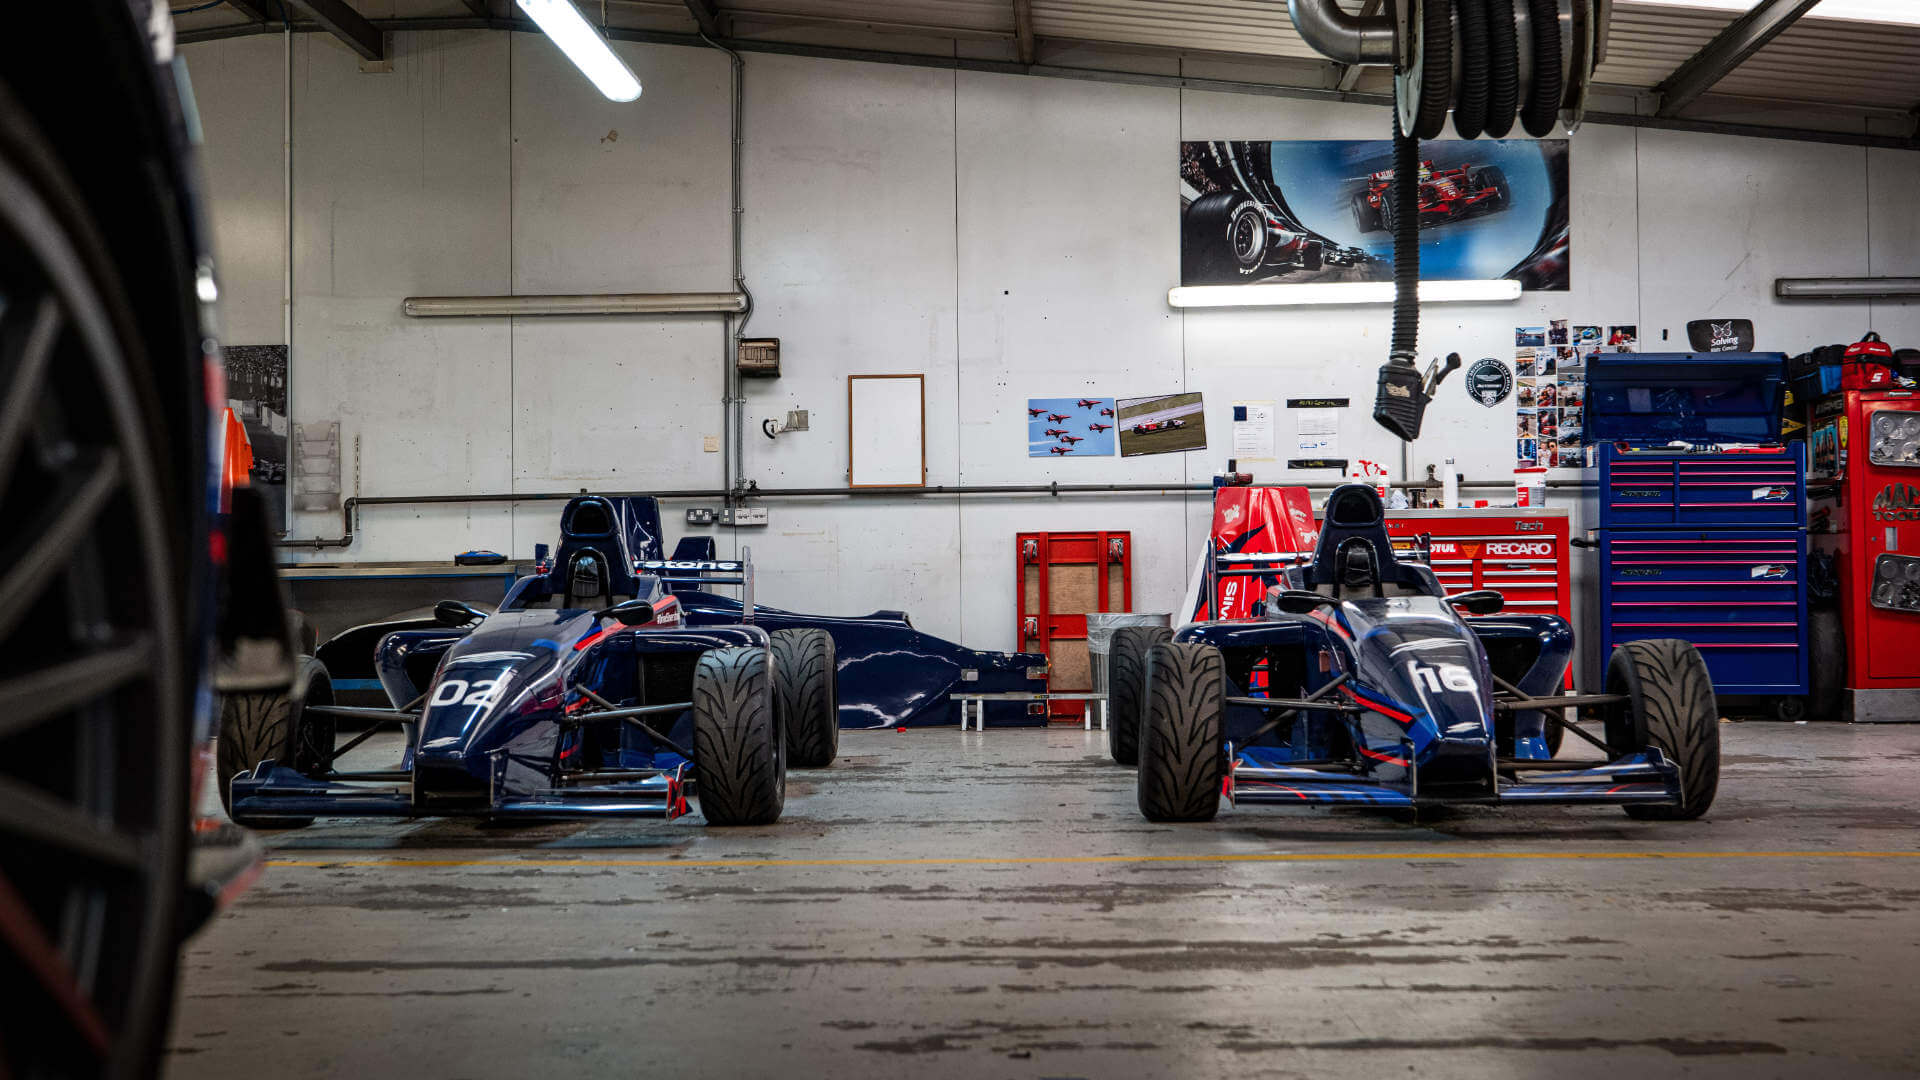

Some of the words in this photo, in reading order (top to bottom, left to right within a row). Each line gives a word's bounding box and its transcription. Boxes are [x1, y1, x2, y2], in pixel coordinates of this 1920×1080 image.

[1711, 336, 1739, 346] Solving
[1514, 520, 1544, 531] Tech
[1430, 543, 1456, 553] OTUL
[1486, 543, 1552, 555] RECARO
